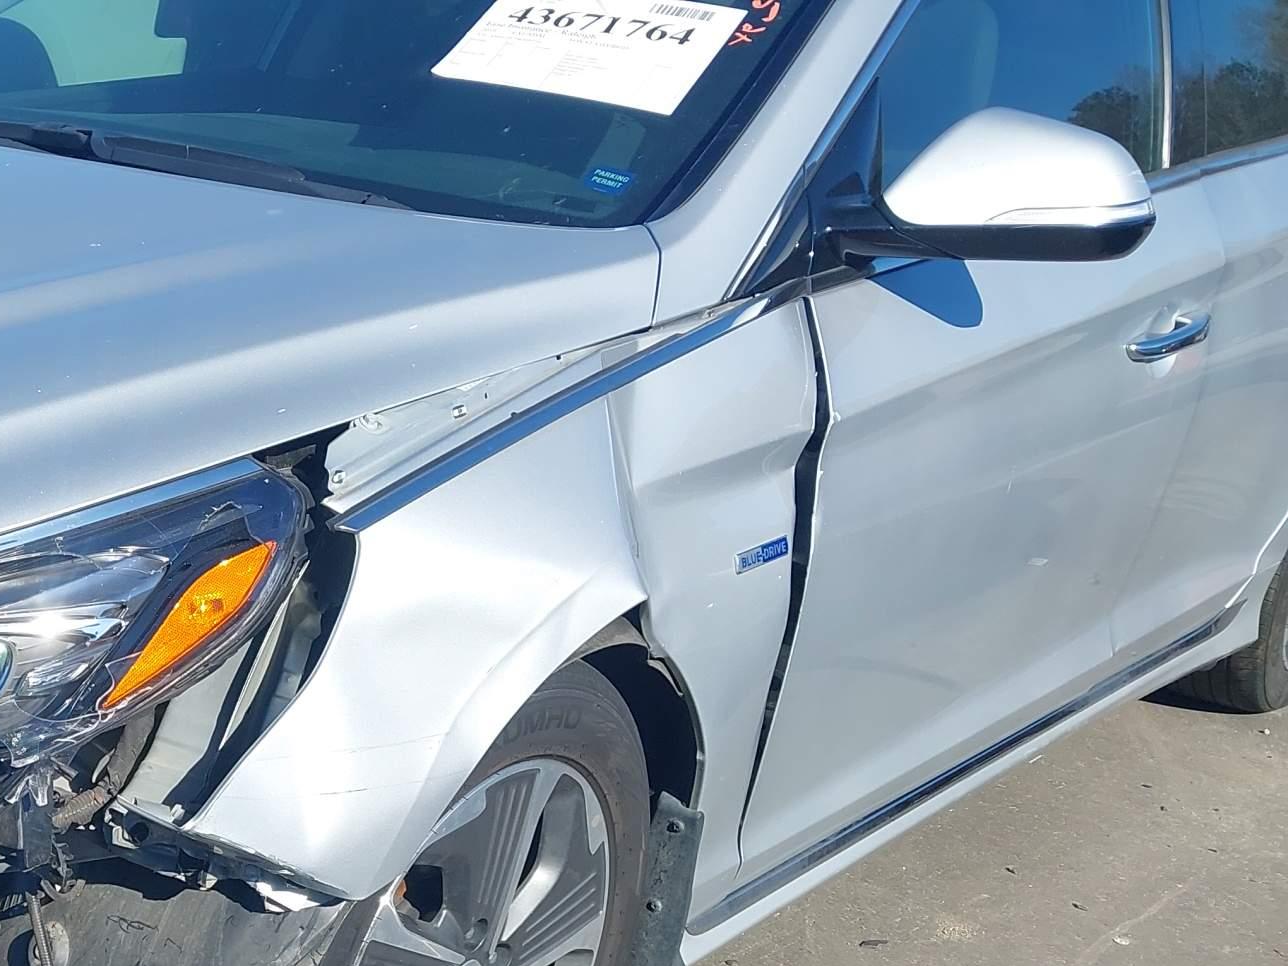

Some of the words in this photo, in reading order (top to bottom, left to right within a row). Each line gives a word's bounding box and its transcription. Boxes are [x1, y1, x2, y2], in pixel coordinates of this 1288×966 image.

[508, 6, 696, 45] 43671764
[591, 176, 623, 188] PERMIT
[594, 169, 630, 183] PARKING
[500, 703, 582, 743] UMHO
